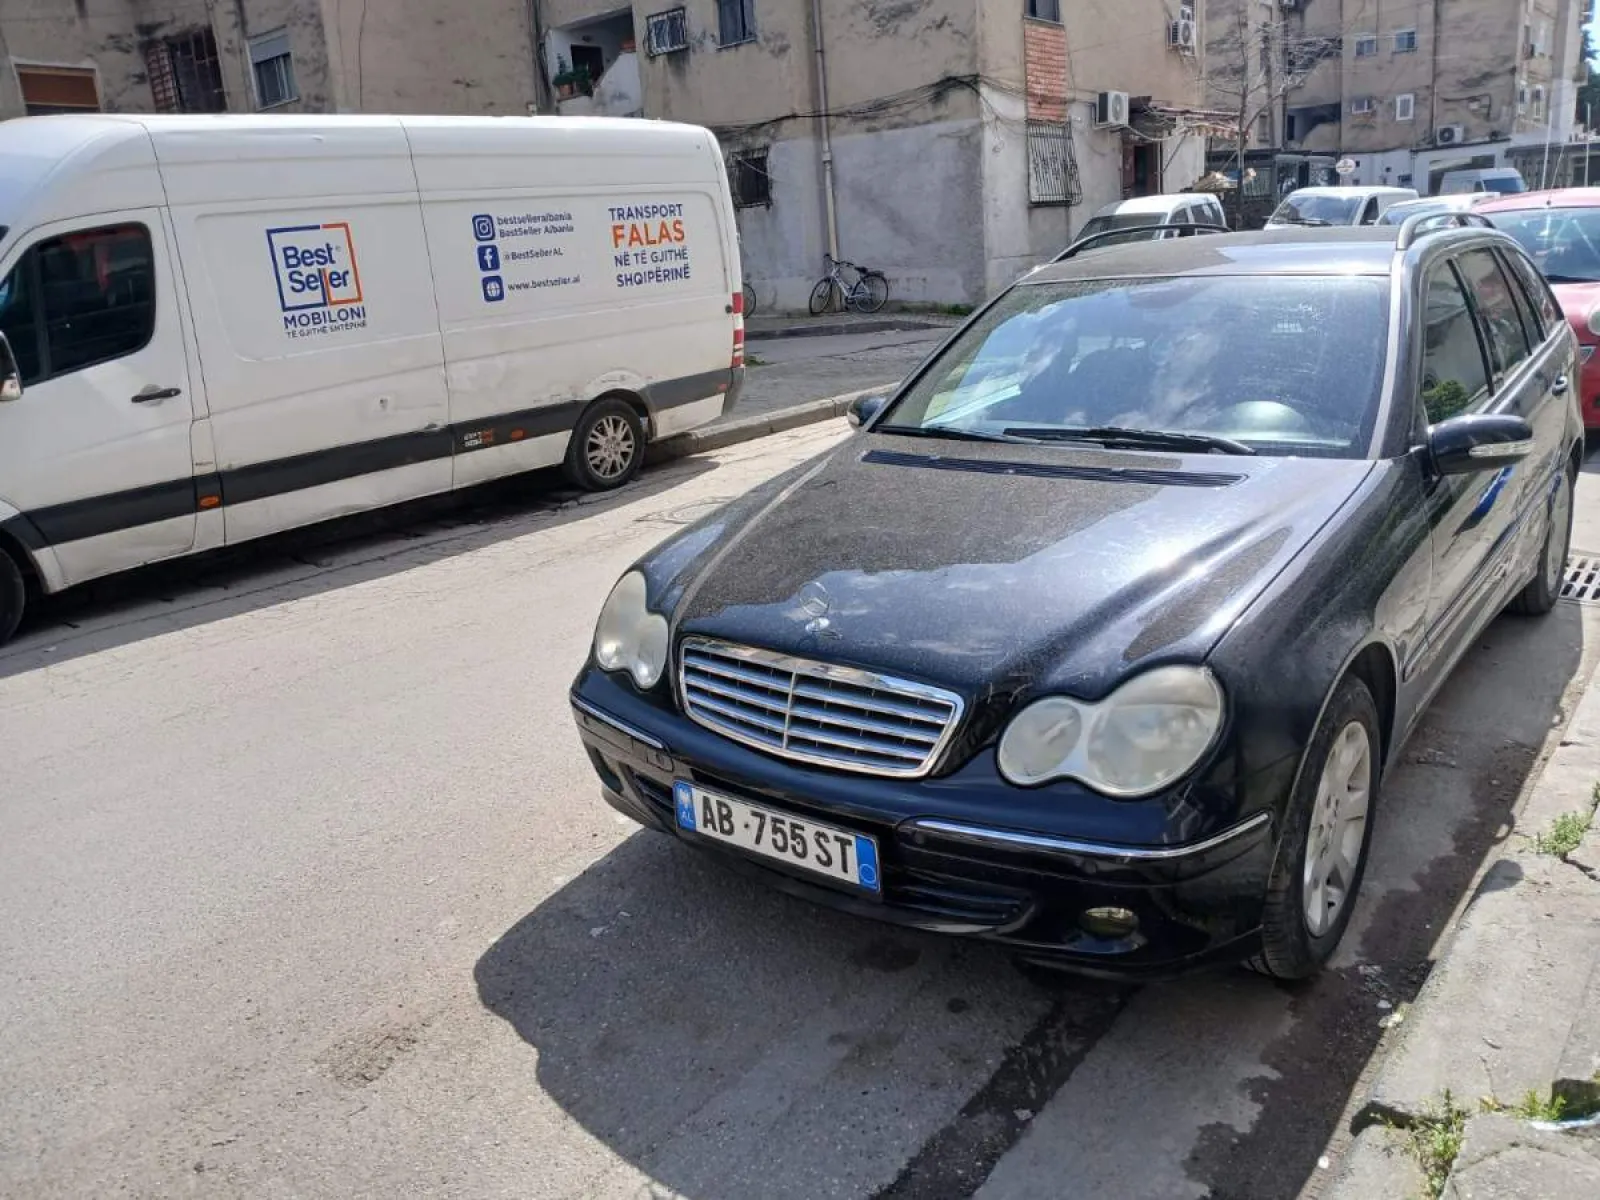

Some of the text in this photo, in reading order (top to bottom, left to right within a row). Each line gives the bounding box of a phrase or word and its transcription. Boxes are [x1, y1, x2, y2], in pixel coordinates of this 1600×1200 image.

[608, 203, 683, 221] TRANSPORT
[611, 219, 685, 249] FALAS
[282, 242, 336, 269] Best
[616, 263, 692, 288] SHQIPËRINË
[283, 306, 367, 330] MOBILONI
[702, 795, 735, 836] AB
[750, 810, 809, 860] 755
[815, 831, 853, 874] ST
